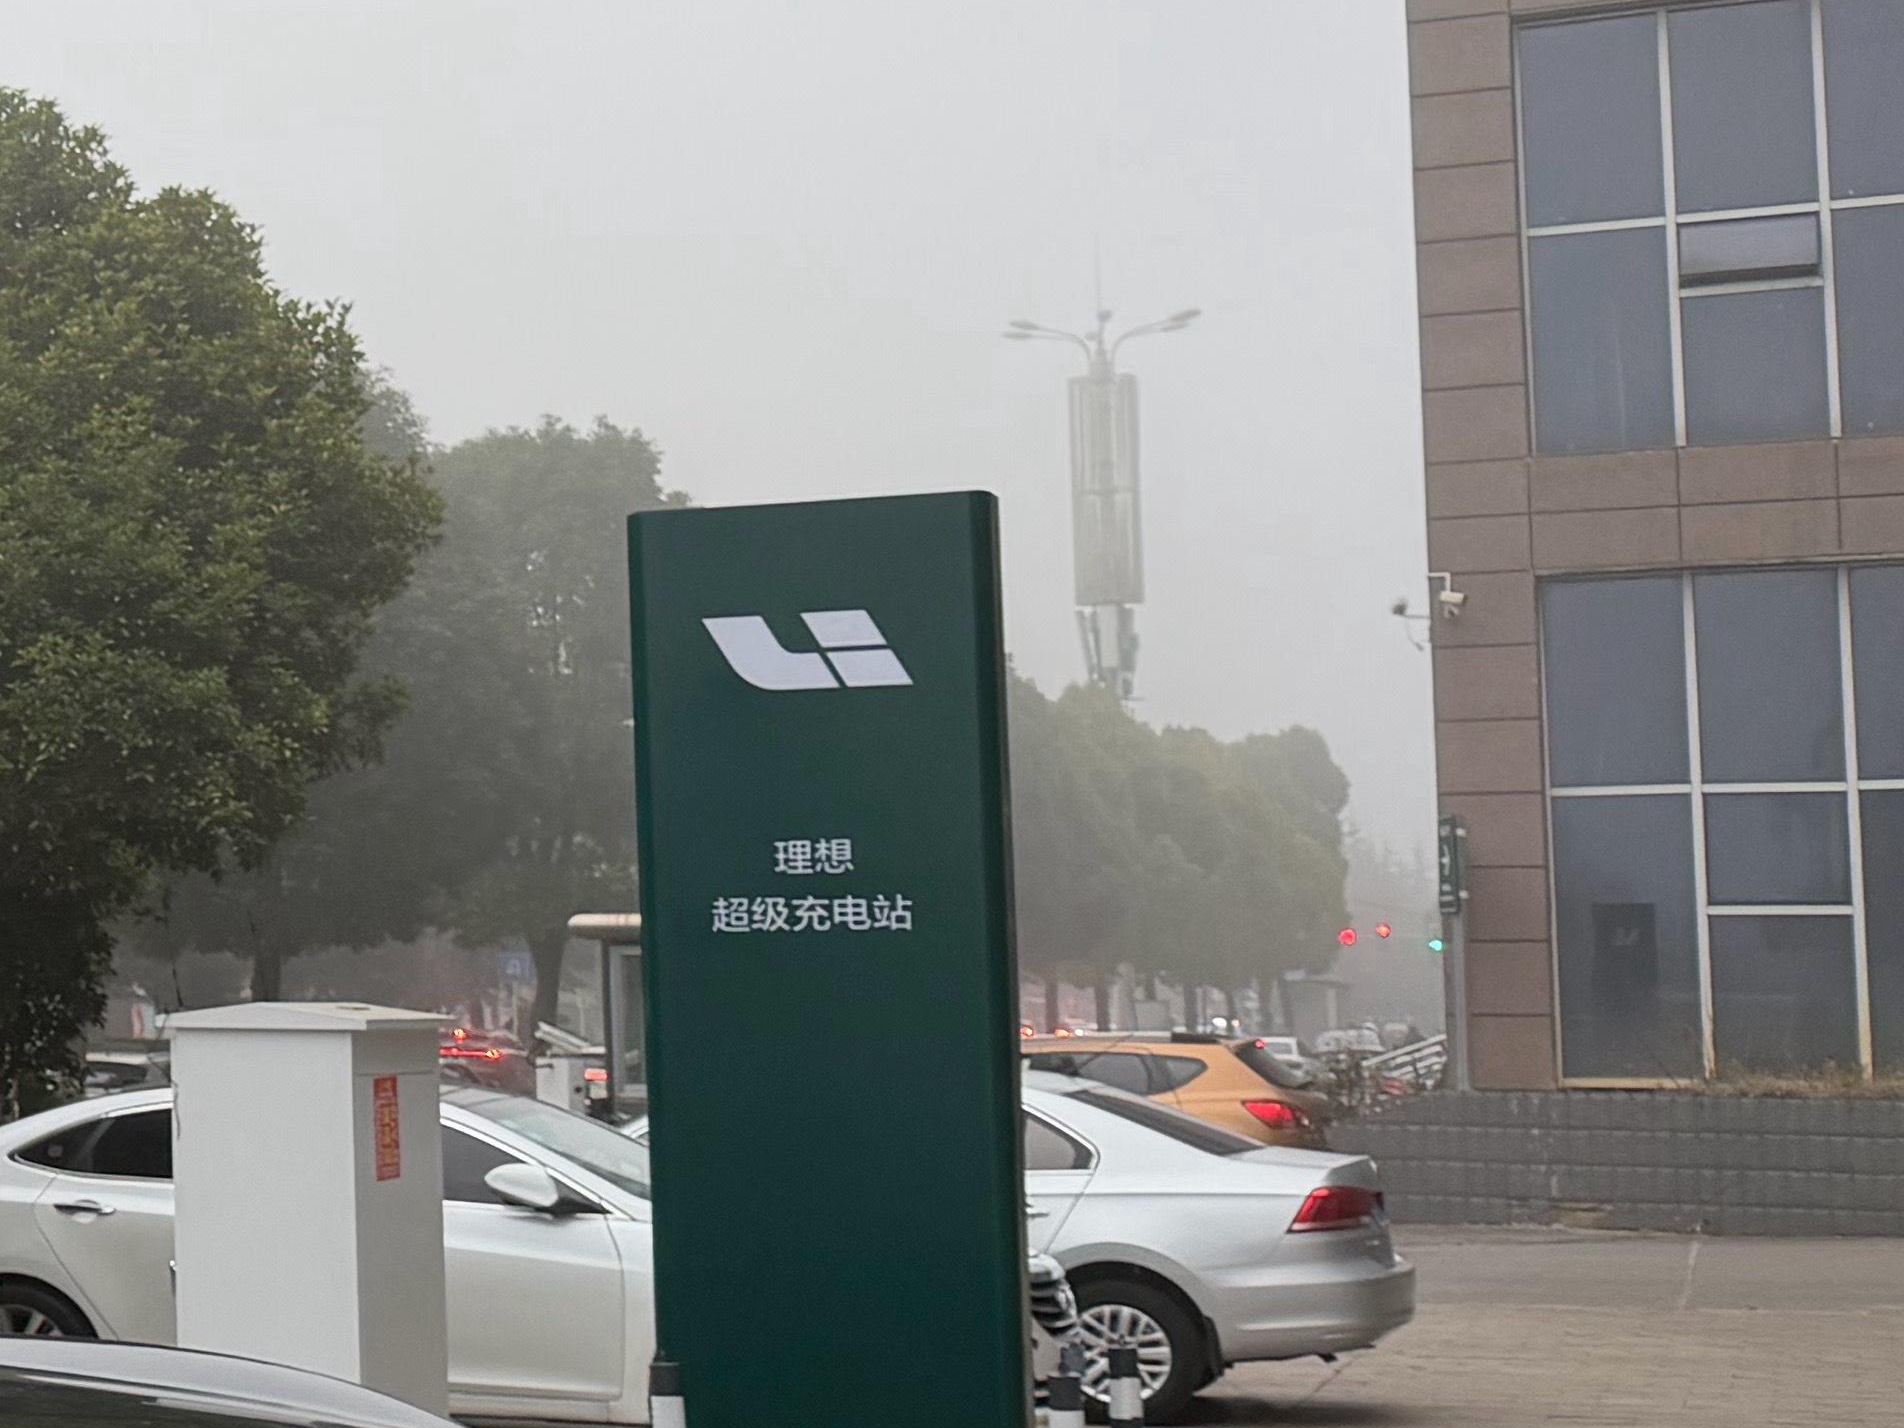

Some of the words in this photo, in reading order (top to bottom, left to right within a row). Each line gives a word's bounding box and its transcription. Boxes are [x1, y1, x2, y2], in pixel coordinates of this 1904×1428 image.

[772, 838, 854, 876] 理想
[711, 894, 914, 934] 超级充电站
